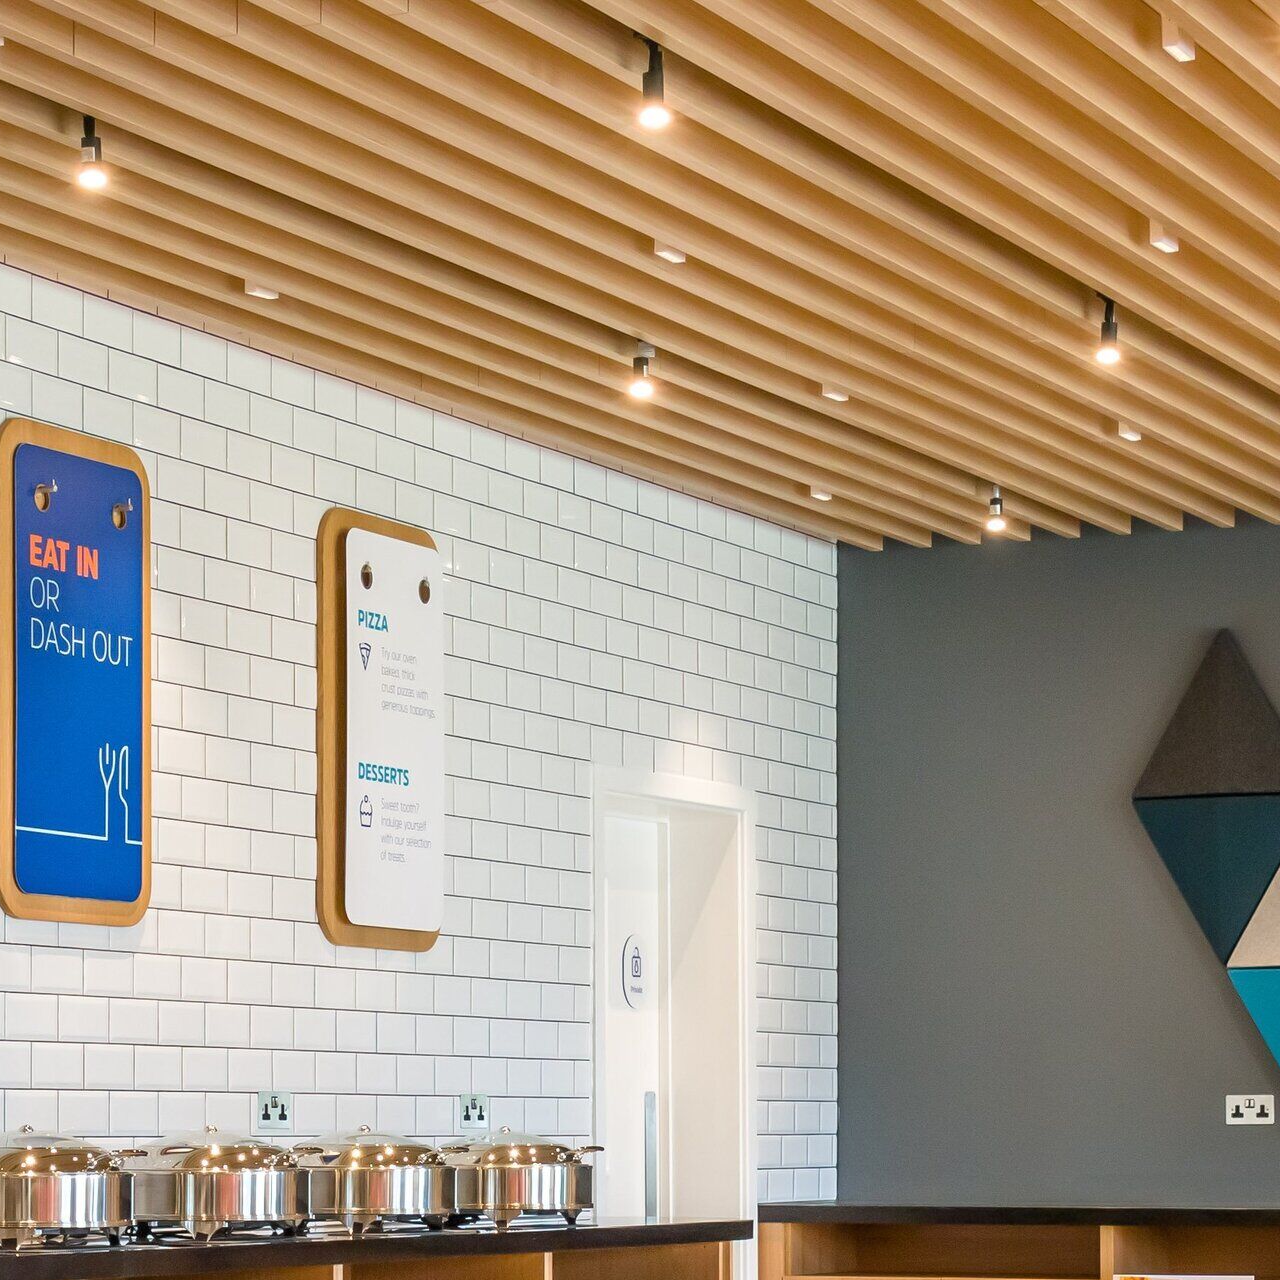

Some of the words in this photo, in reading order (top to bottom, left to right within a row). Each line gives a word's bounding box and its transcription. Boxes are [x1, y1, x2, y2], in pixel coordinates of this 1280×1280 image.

[29, 533, 71, 573] EAT
[76, 544, 99, 581] IN
[29, 576, 60, 613] OR
[357, 608, 389, 633] PIZZA
[30, 616, 86, 659] DASH
[92, 630, 134, 667] OUT
[358, 761, 410, 787] DESSERTS
